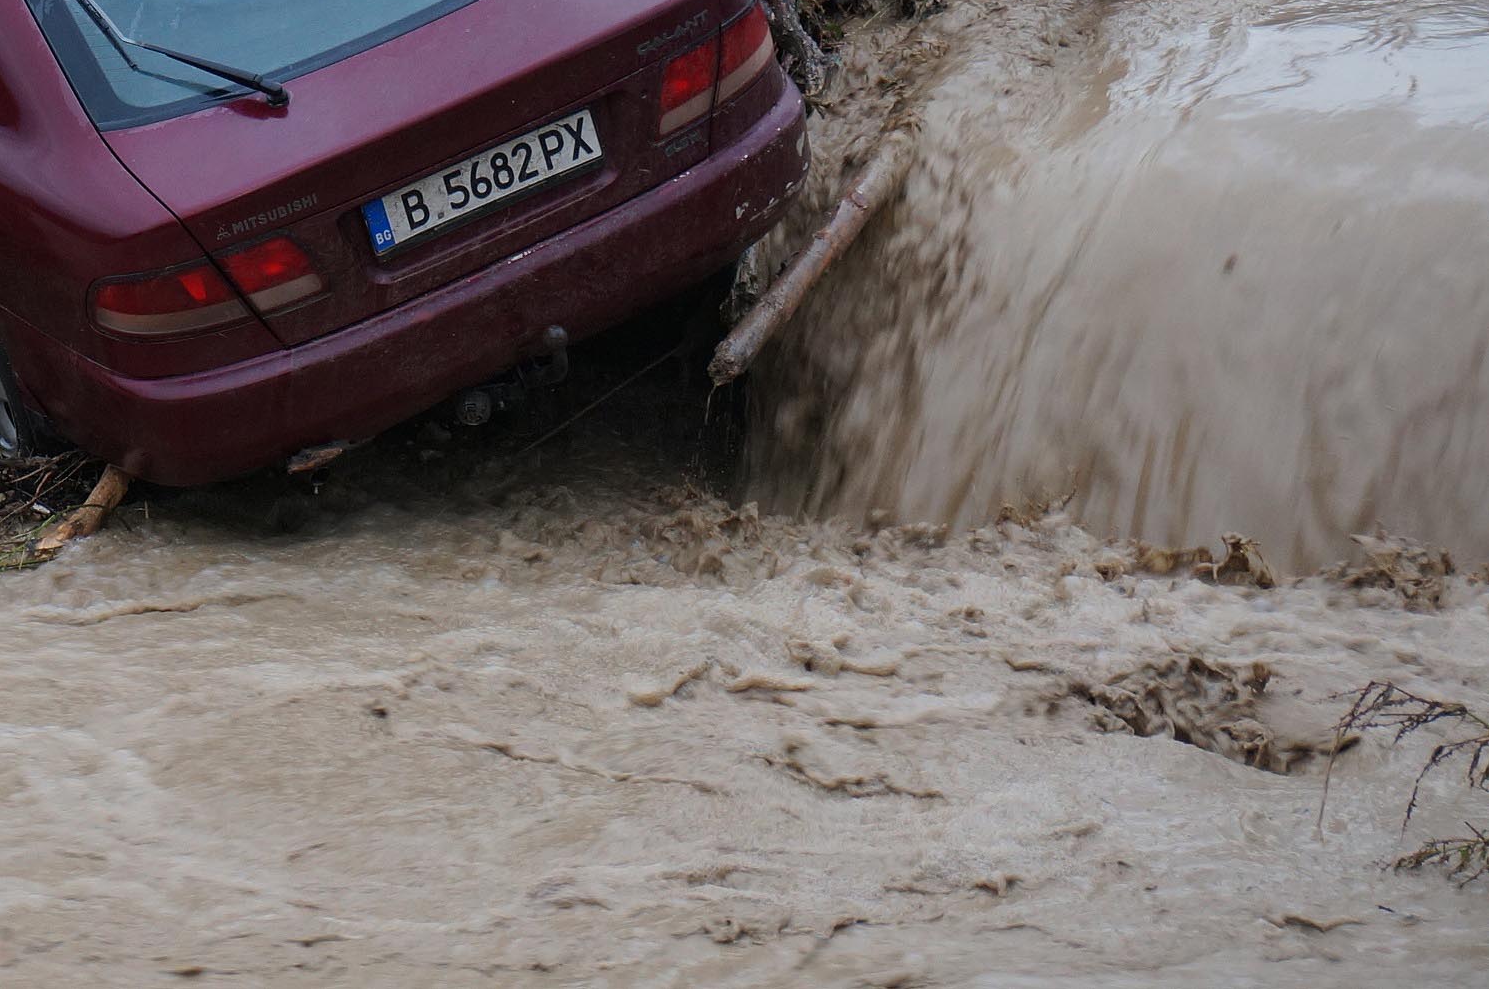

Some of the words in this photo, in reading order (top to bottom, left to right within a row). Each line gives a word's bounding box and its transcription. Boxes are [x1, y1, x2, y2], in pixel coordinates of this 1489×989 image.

[401, 189, 430, 231] B
[443, 142, 540, 211] 5682
[538, 117, 594, 171] PX
[231, 193, 318, 234] MITSUBISHI
[375, 229, 393, 245] BG
